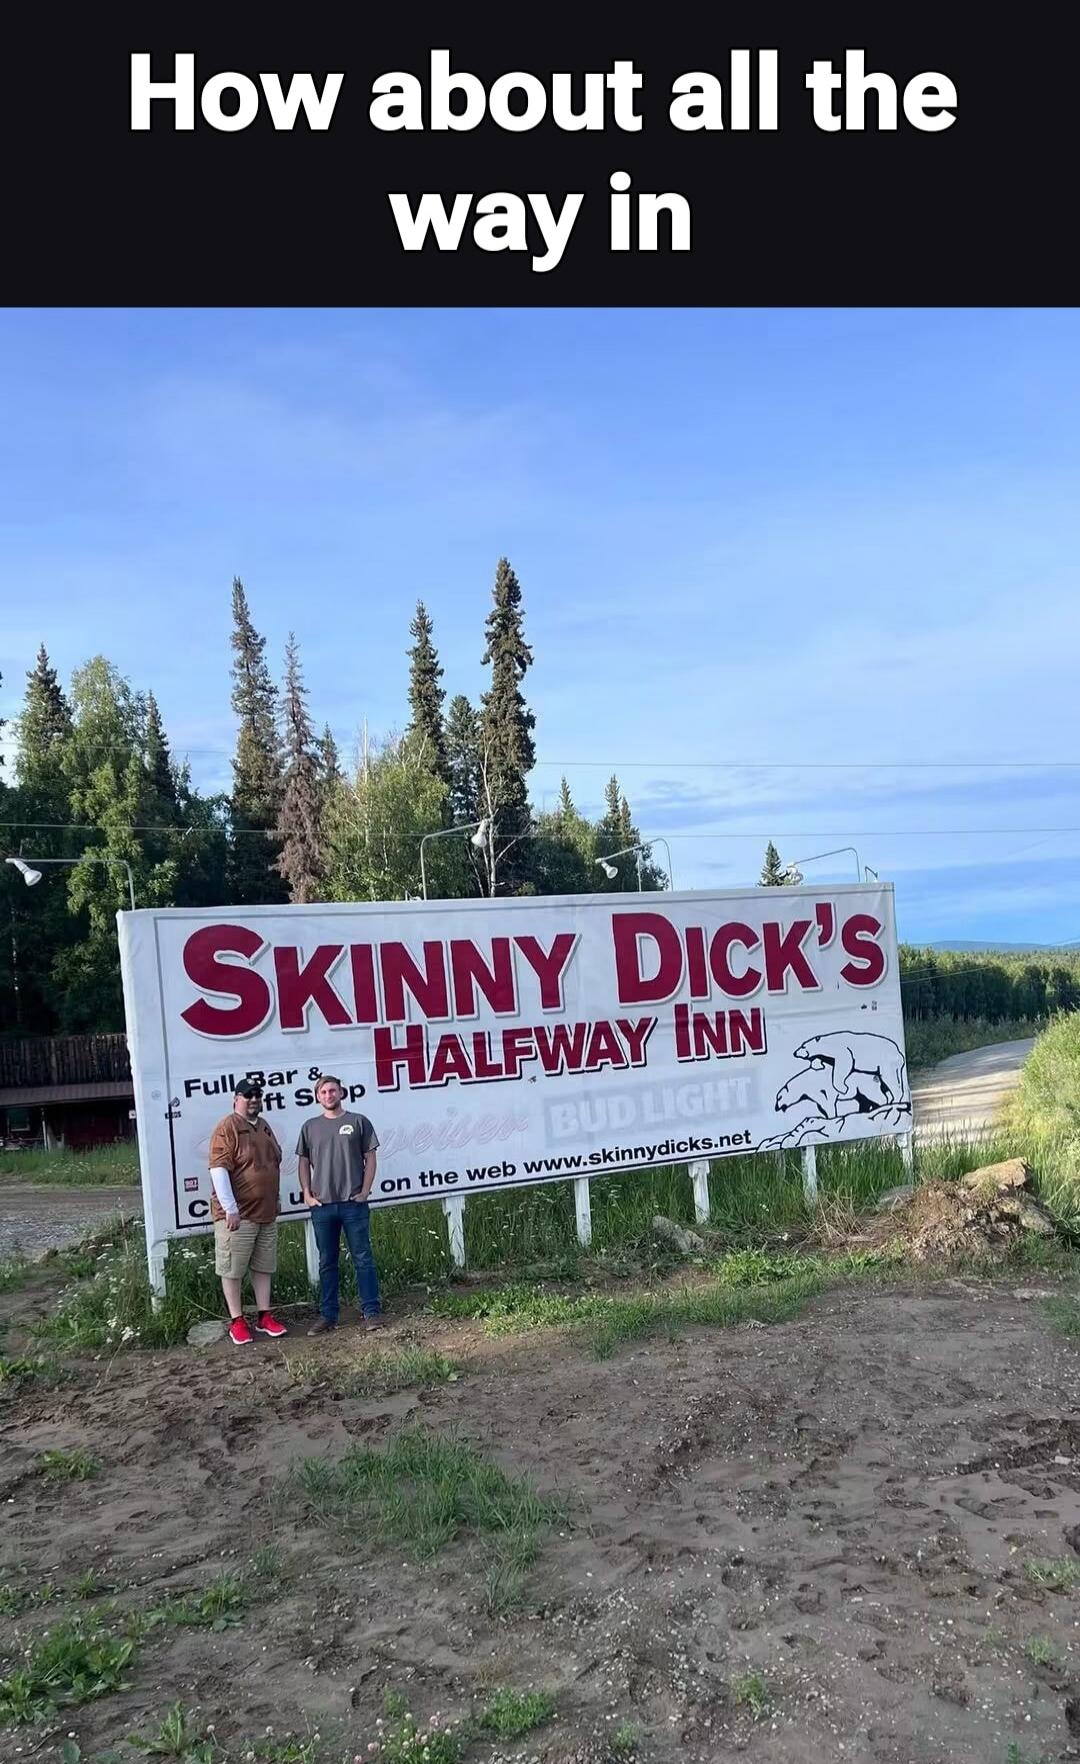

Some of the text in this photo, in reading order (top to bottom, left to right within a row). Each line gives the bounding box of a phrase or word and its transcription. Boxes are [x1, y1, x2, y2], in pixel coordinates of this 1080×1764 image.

[180, 902, 885, 1037] SKINNY DICK'S
[373, 1002, 766, 1091] HALFWAY INN
[184, 1067, 322, 1098] Full Bar &
[294, 1083, 366, 1107] Sp
[551, 1077, 752, 1138] BUD LIGHT
[380, 1177, 411, 1193] on
[418, 1170, 459, 1188] the
[466, 1161, 516, 1182] web
[523, 1130, 752, 1174] www.skinnydicks.net
